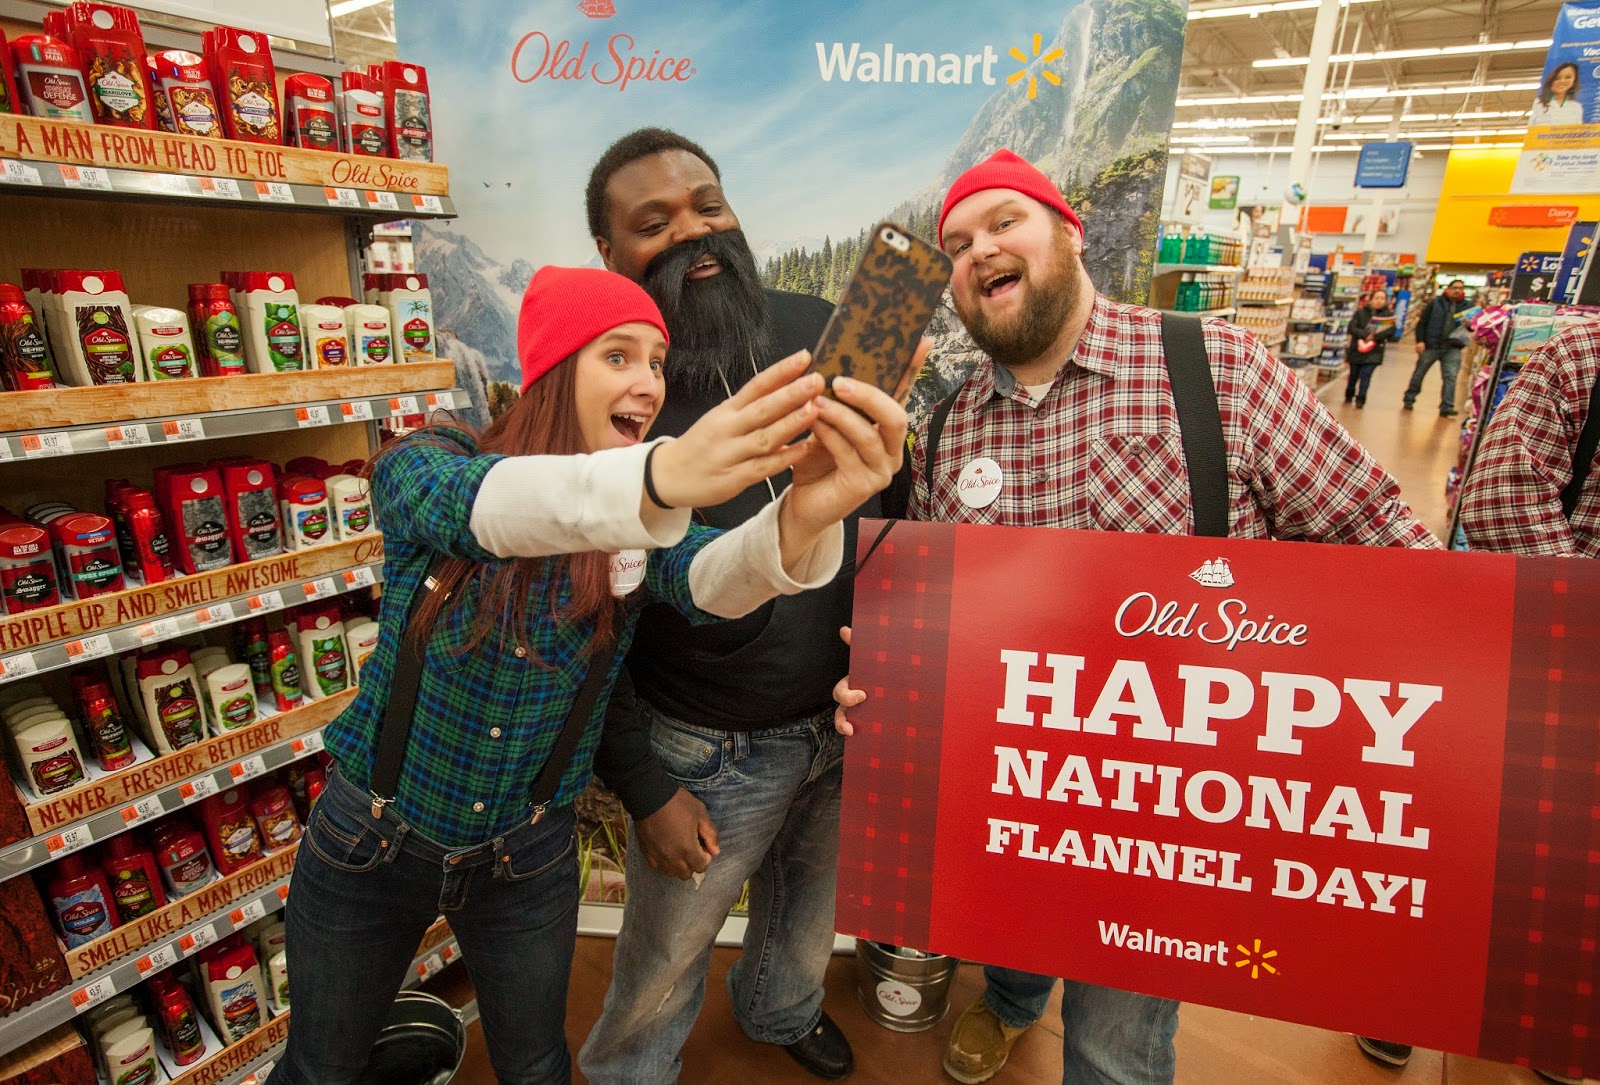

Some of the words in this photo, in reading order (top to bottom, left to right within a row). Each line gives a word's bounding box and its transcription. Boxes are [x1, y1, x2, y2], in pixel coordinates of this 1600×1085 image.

[511, 31, 588, 84] Old
[591, 33, 692, 92] Spice
[815, 42, 998, 86] Walmart
[43, 91, 77, 101] DEFENSE
[16, 122, 34, 154] A
[40, 124, 94, 160] MAN
[101, 131, 158, 166] FROM
[163, 139, 217, 172] HEAD
[222, 146, 249, 175] TO
[254, 149, 287, 179] TOE
[331, 158, 371, 184] Old
[371, 163, 420, 190] Spice
[1547, 208, 1575, 218] Dairy
[960, 478, 977, 491] Old
[977, 476, 1000, 488] Spice
[615, 557, 644, 573] Spice
[0, 611, 70, 651] TRIPLE
[76, 603, 105, 631] UP
[118, 592, 157, 624] AND
[164, 577, 218, 610] SMELL
[226, 557, 300, 596] AWESOME
[1114, 592, 1198, 638] Old
[1198, 598, 1309, 651] Spice
[996, 648, 1443, 767] HAPPY
[37, 786, 116, 829] NEWER,
[121, 754, 205, 797] FRESHER,
[207, 722, 282, 765] BETTERER
[990, 745, 1430, 850] NATIONAL
[985, 817, 1253, 893] FLANNEL
[1271, 858, 1427, 918] DAY!
[64, 911, 80, 922] Old
[80, 906, 100, 918] Spice
[73, 916, 96, 926] POLAR
[78, 932, 133, 972] SMELL
[138, 911, 174, 943] LIKE
[181, 904, 193, 922] A
[197, 882, 233, 913] MAN
[238, 861, 276, 894] FROM
[1098, 919, 1230, 967] Walmart
[879, 990, 895, 1001] Old
[895, 996, 918, 1006] Spice
